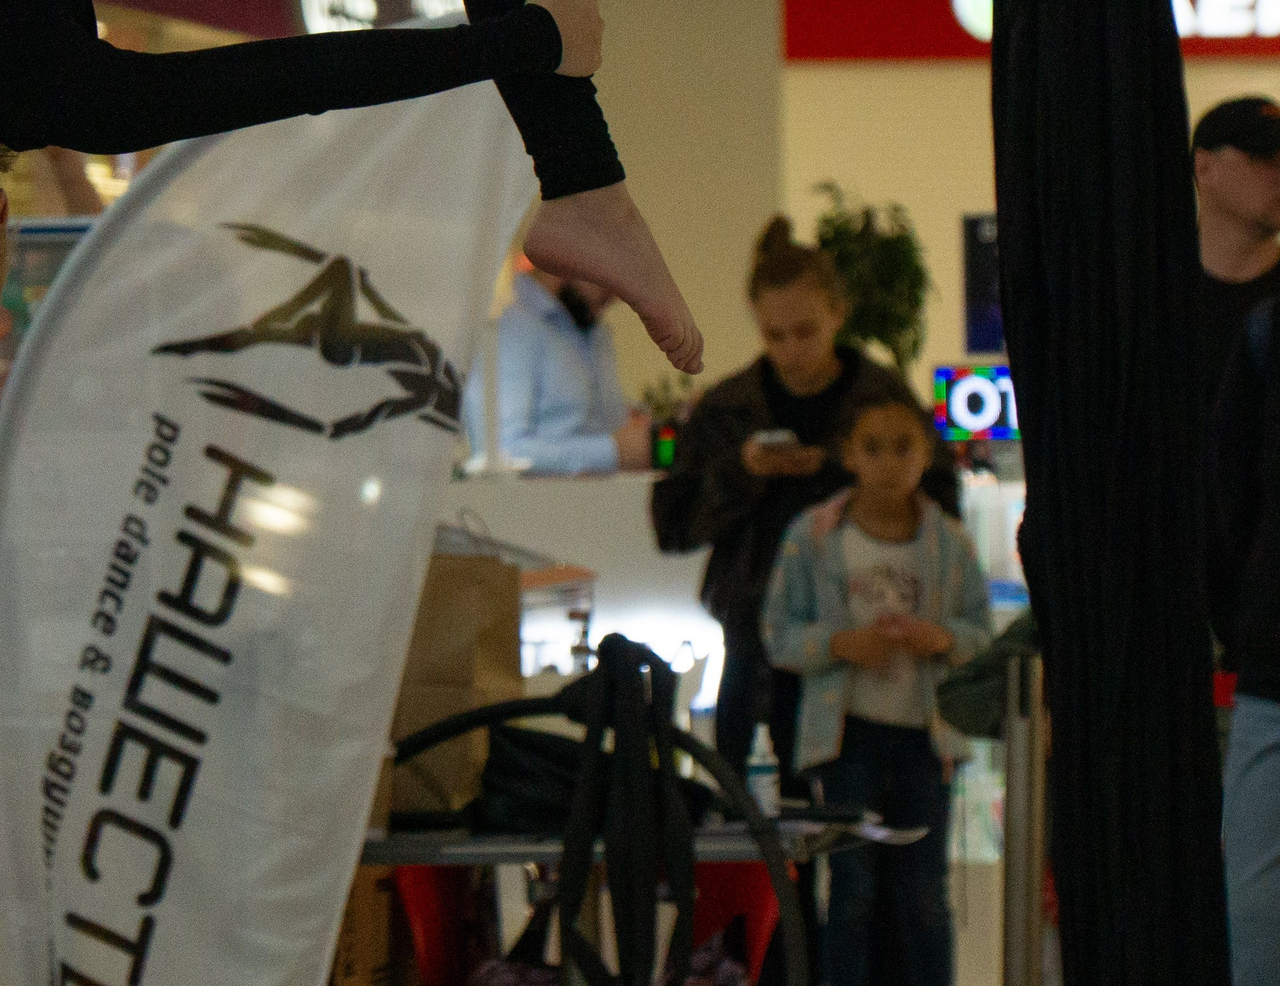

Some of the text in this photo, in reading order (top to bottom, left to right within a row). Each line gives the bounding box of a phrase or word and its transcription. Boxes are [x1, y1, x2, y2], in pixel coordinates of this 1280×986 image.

[132, 412, 181, 504] pole
[91, 513, 150, 636] dance
[78, 643, 113, 675] &
[60, 443, 277, 986] НАШЕСТ
